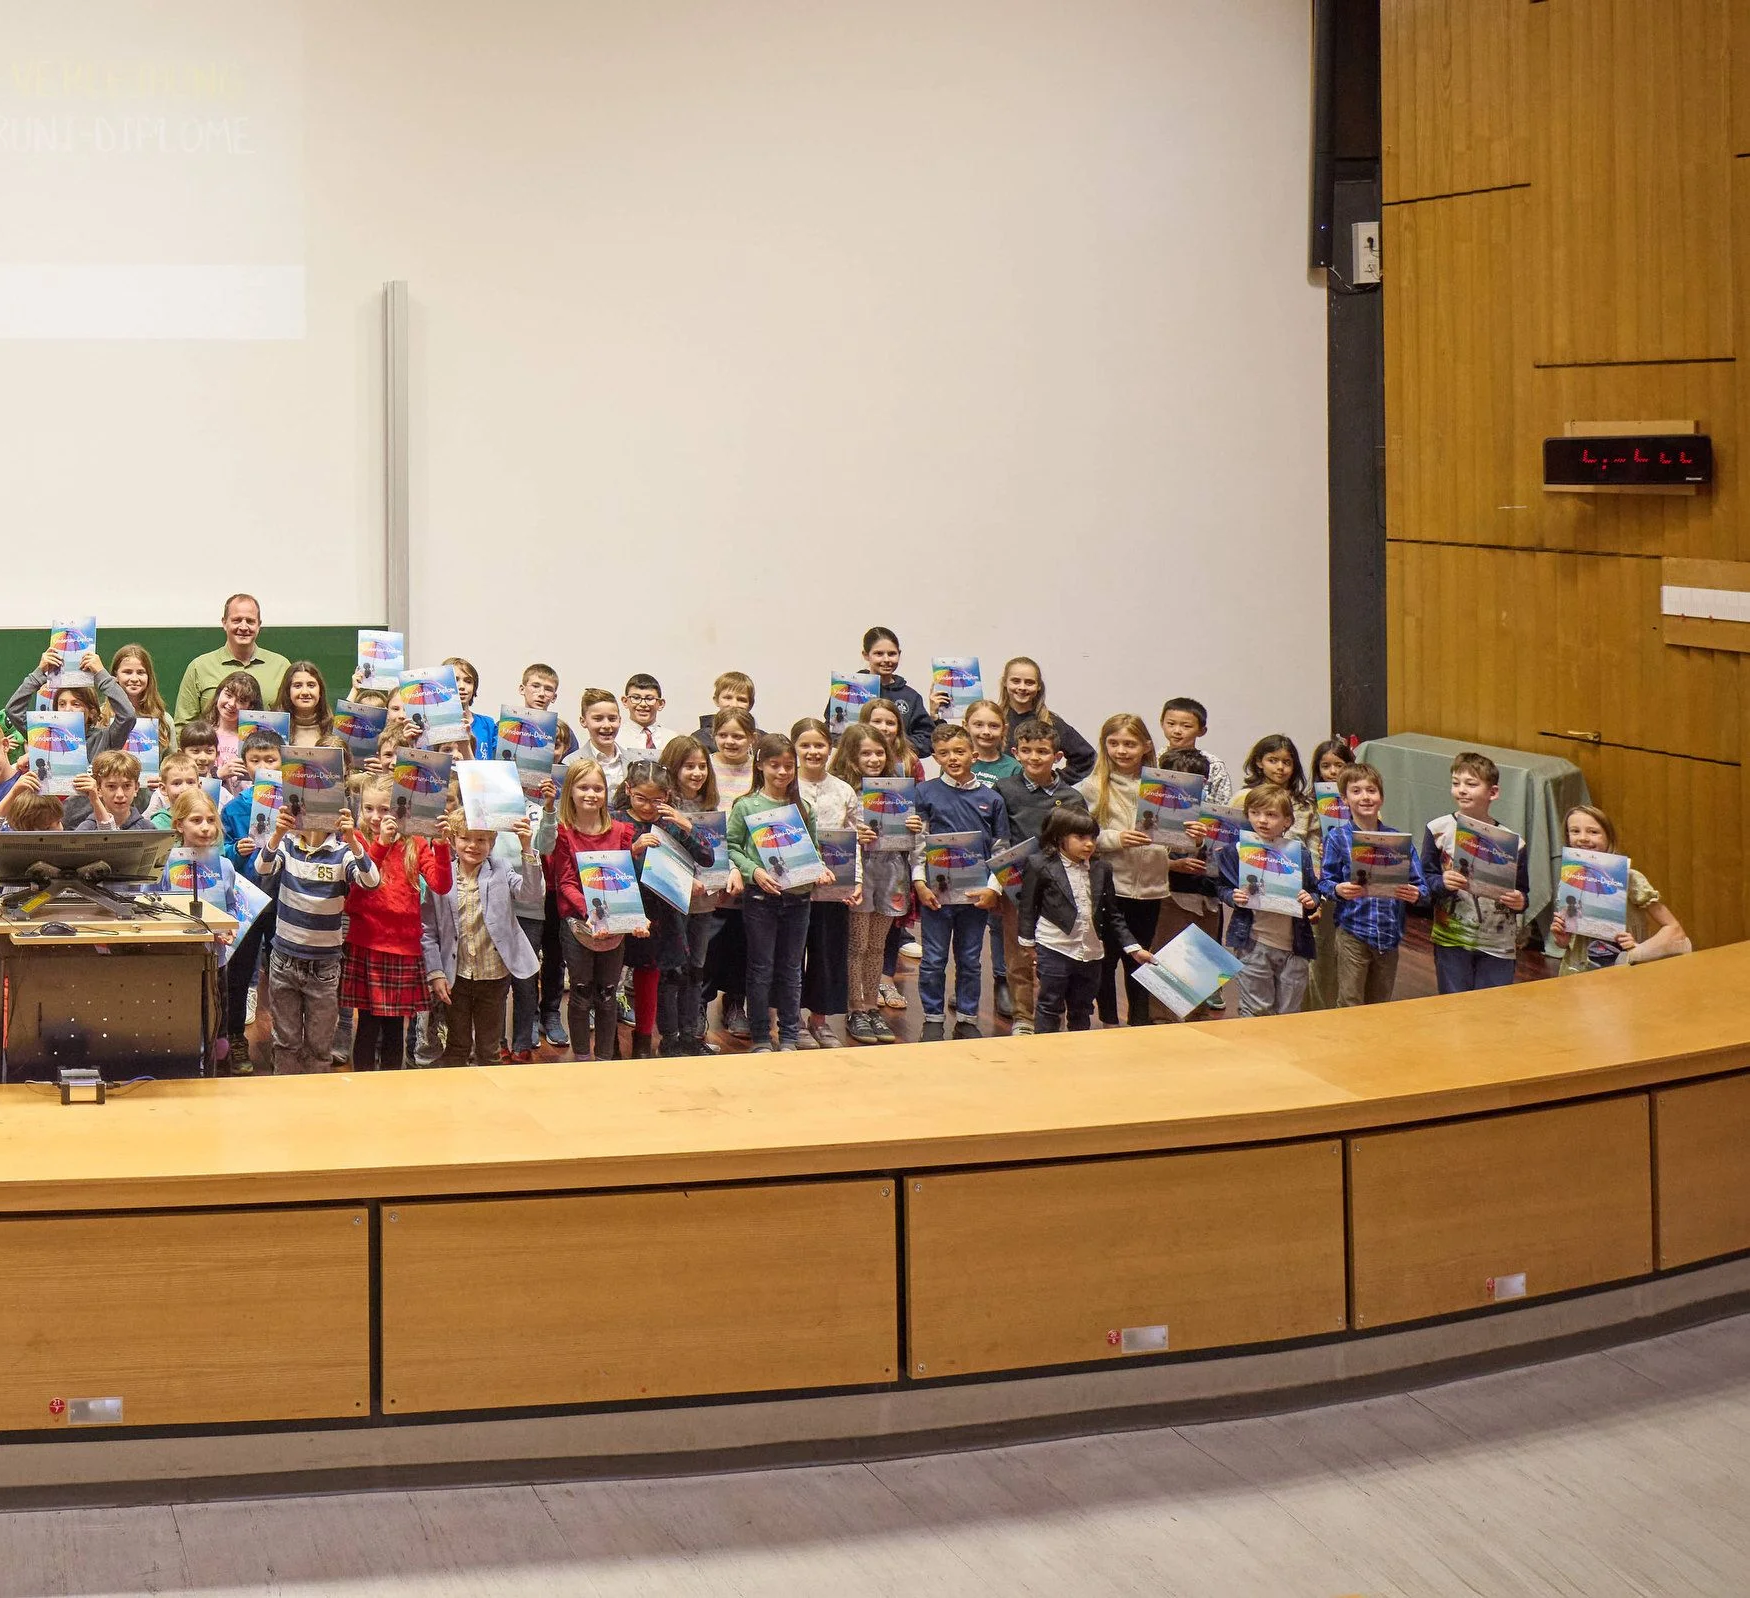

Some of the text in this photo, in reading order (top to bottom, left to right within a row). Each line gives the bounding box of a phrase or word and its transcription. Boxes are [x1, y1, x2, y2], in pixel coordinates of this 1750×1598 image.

[405, 687, 455, 698] Kinderuni-Diplom
[502, 728, 553, 740] Kinderuni-Diplom
[287, 771, 339, 780] Kinderuni-Diplom
[868, 798, 912, 806] Kinderuni-Diplom
[757, 828, 804, 841] Kinderuni-Diplom
[1458, 837, 1514, 859] Kinderuni-Diplom
[1244, 853, 1299, 868] Kinderuni-Diplom
[317, 866, 334, 880] 85
[1564, 872, 1624, 888] Kinderuni-Diplom
